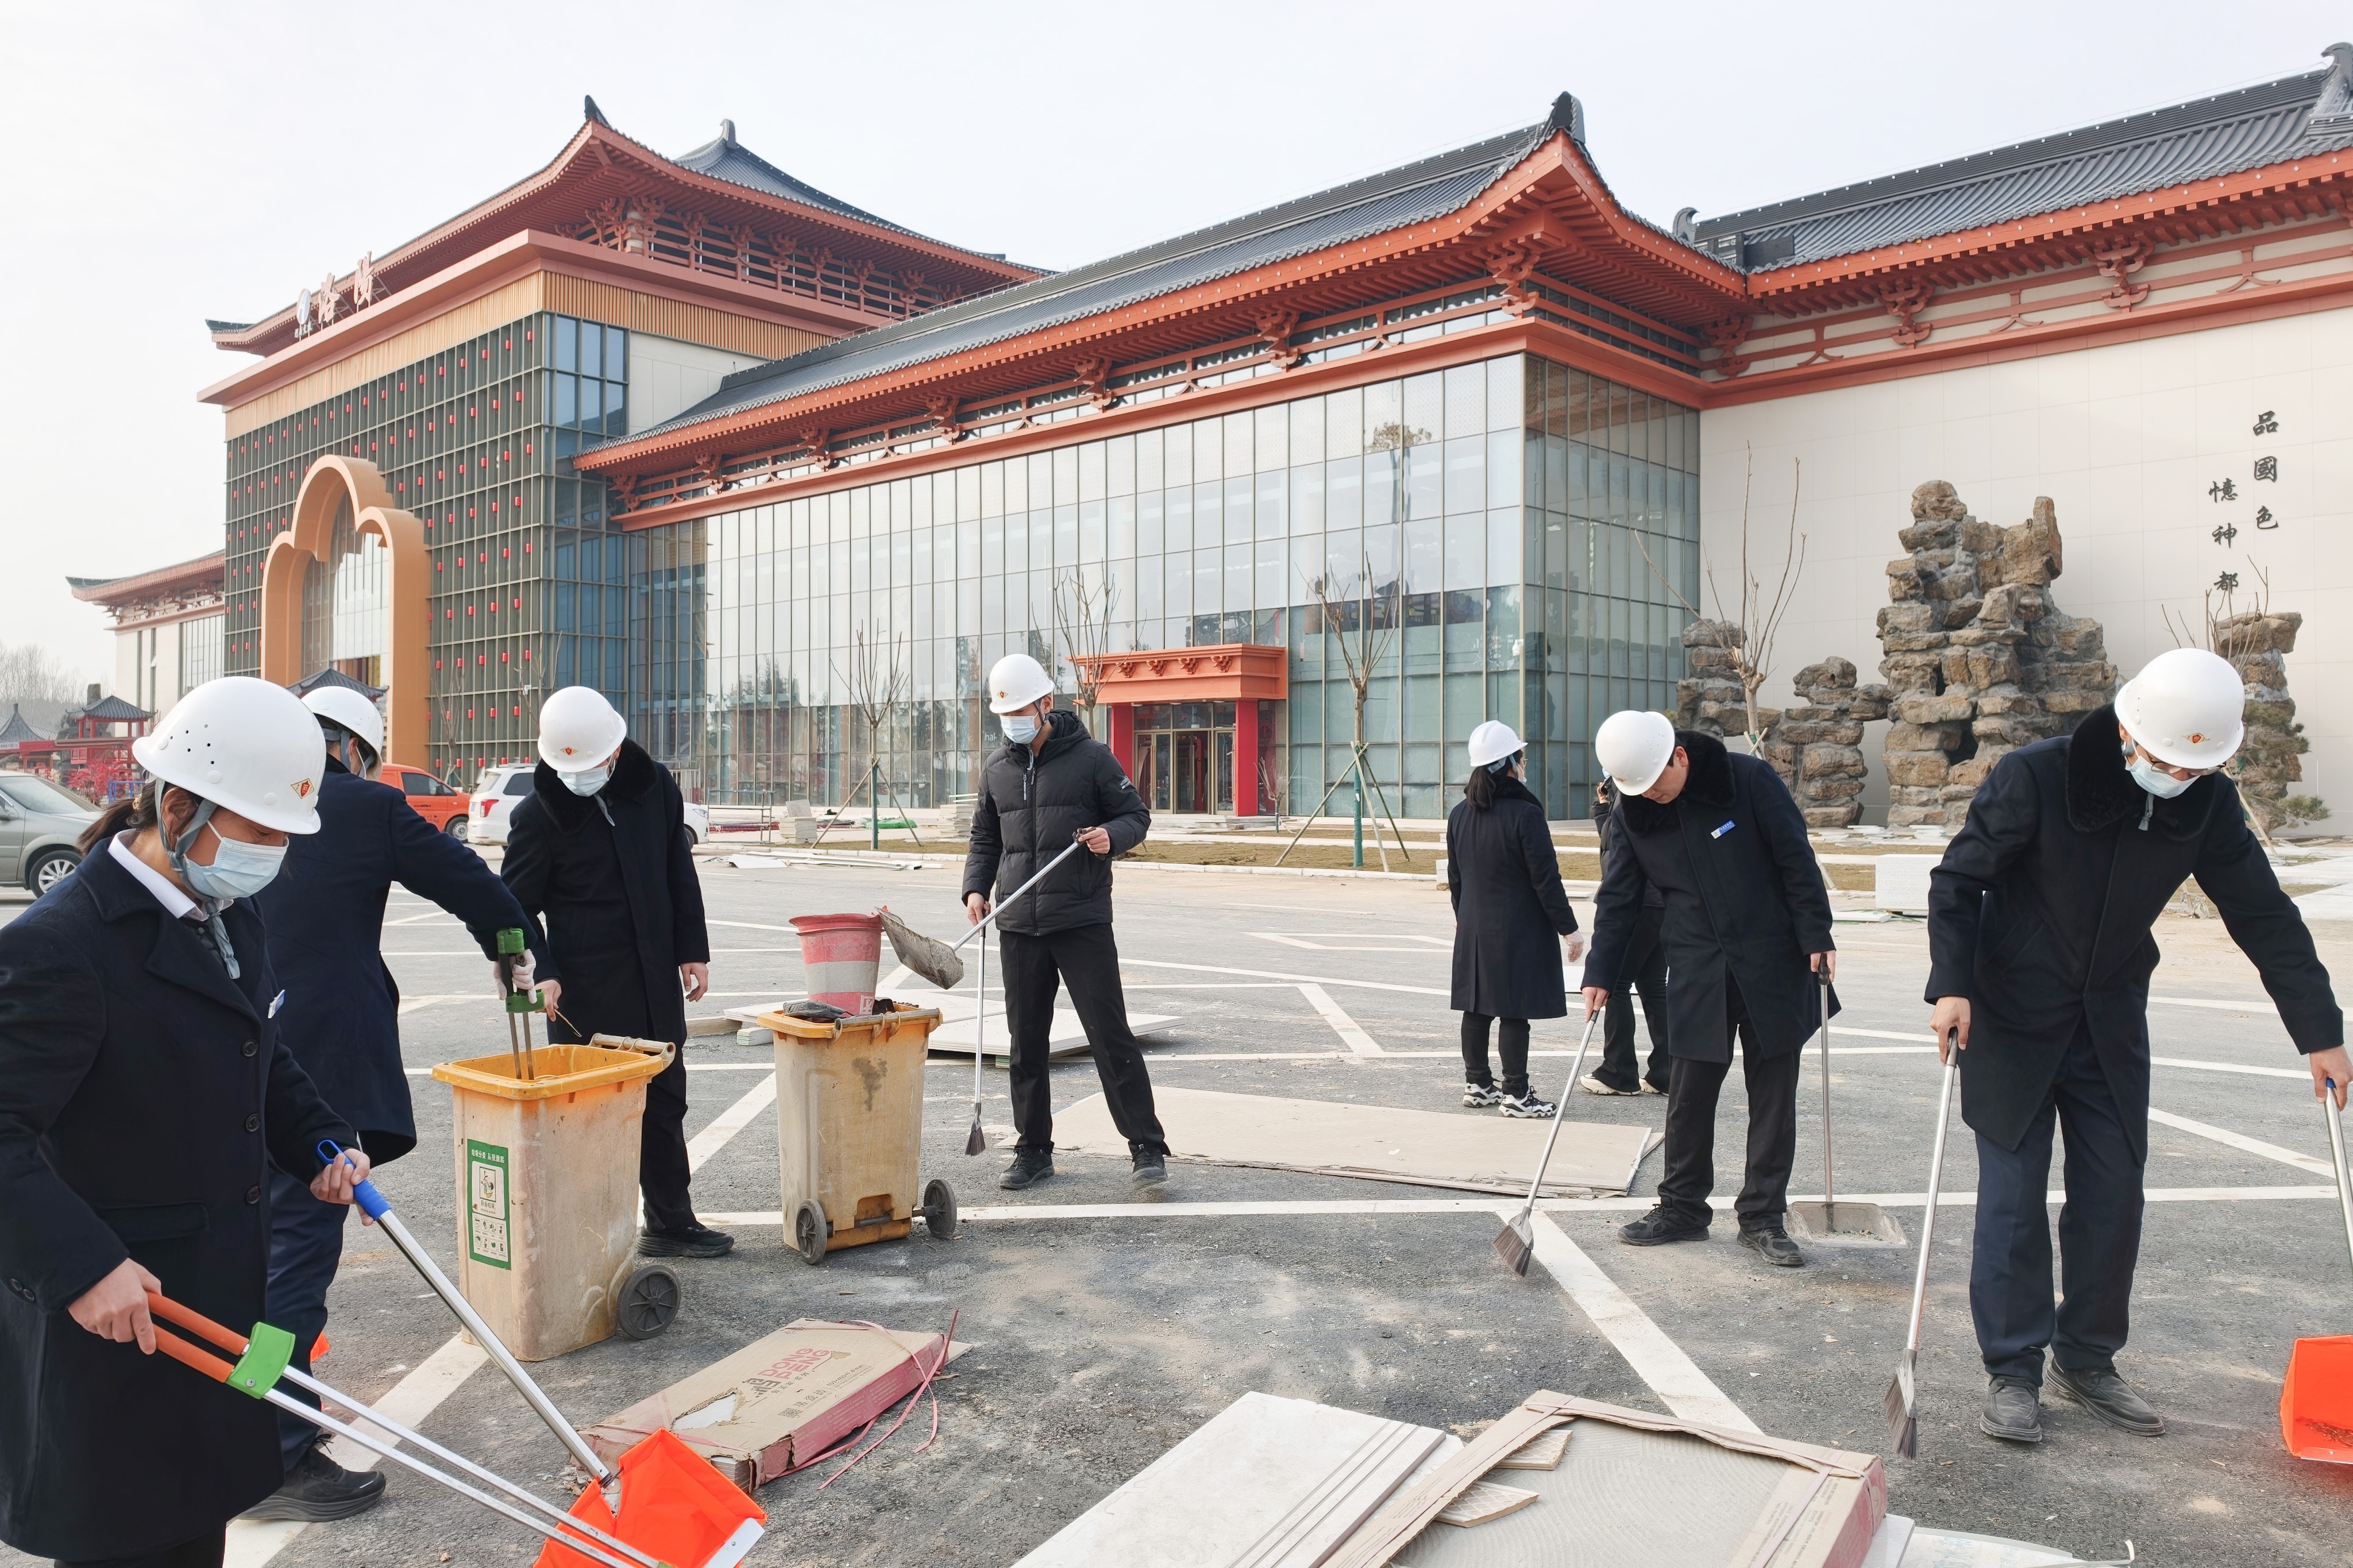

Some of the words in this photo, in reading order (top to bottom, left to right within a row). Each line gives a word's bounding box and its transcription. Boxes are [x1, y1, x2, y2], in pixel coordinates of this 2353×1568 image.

[2252, 410, 2279, 530] 品國色
[2208, 478, 2239, 594] 憶神都
[758, 1348, 814, 1377] DONG
[774, 1350, 830, 1379] PENG
